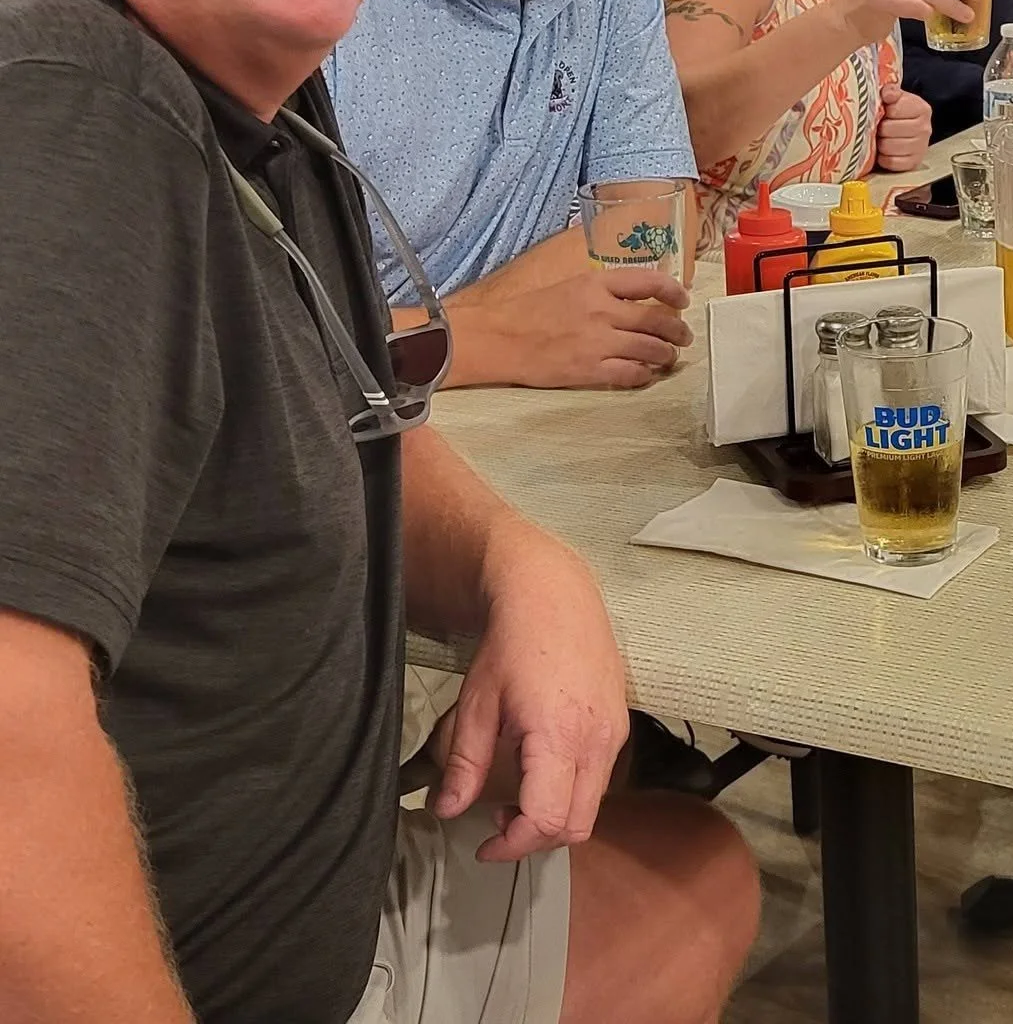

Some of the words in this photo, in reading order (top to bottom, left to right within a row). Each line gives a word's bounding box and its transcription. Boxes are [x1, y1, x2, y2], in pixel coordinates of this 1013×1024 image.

[558, 61, 577, 84] OPEN
[873, 405, 942, 429] BUD
[864, 423, 950, 451] LIGHT
[866, 451, 902, 461] PREMIUM
[902, 453, 925, 461] LIGHT
